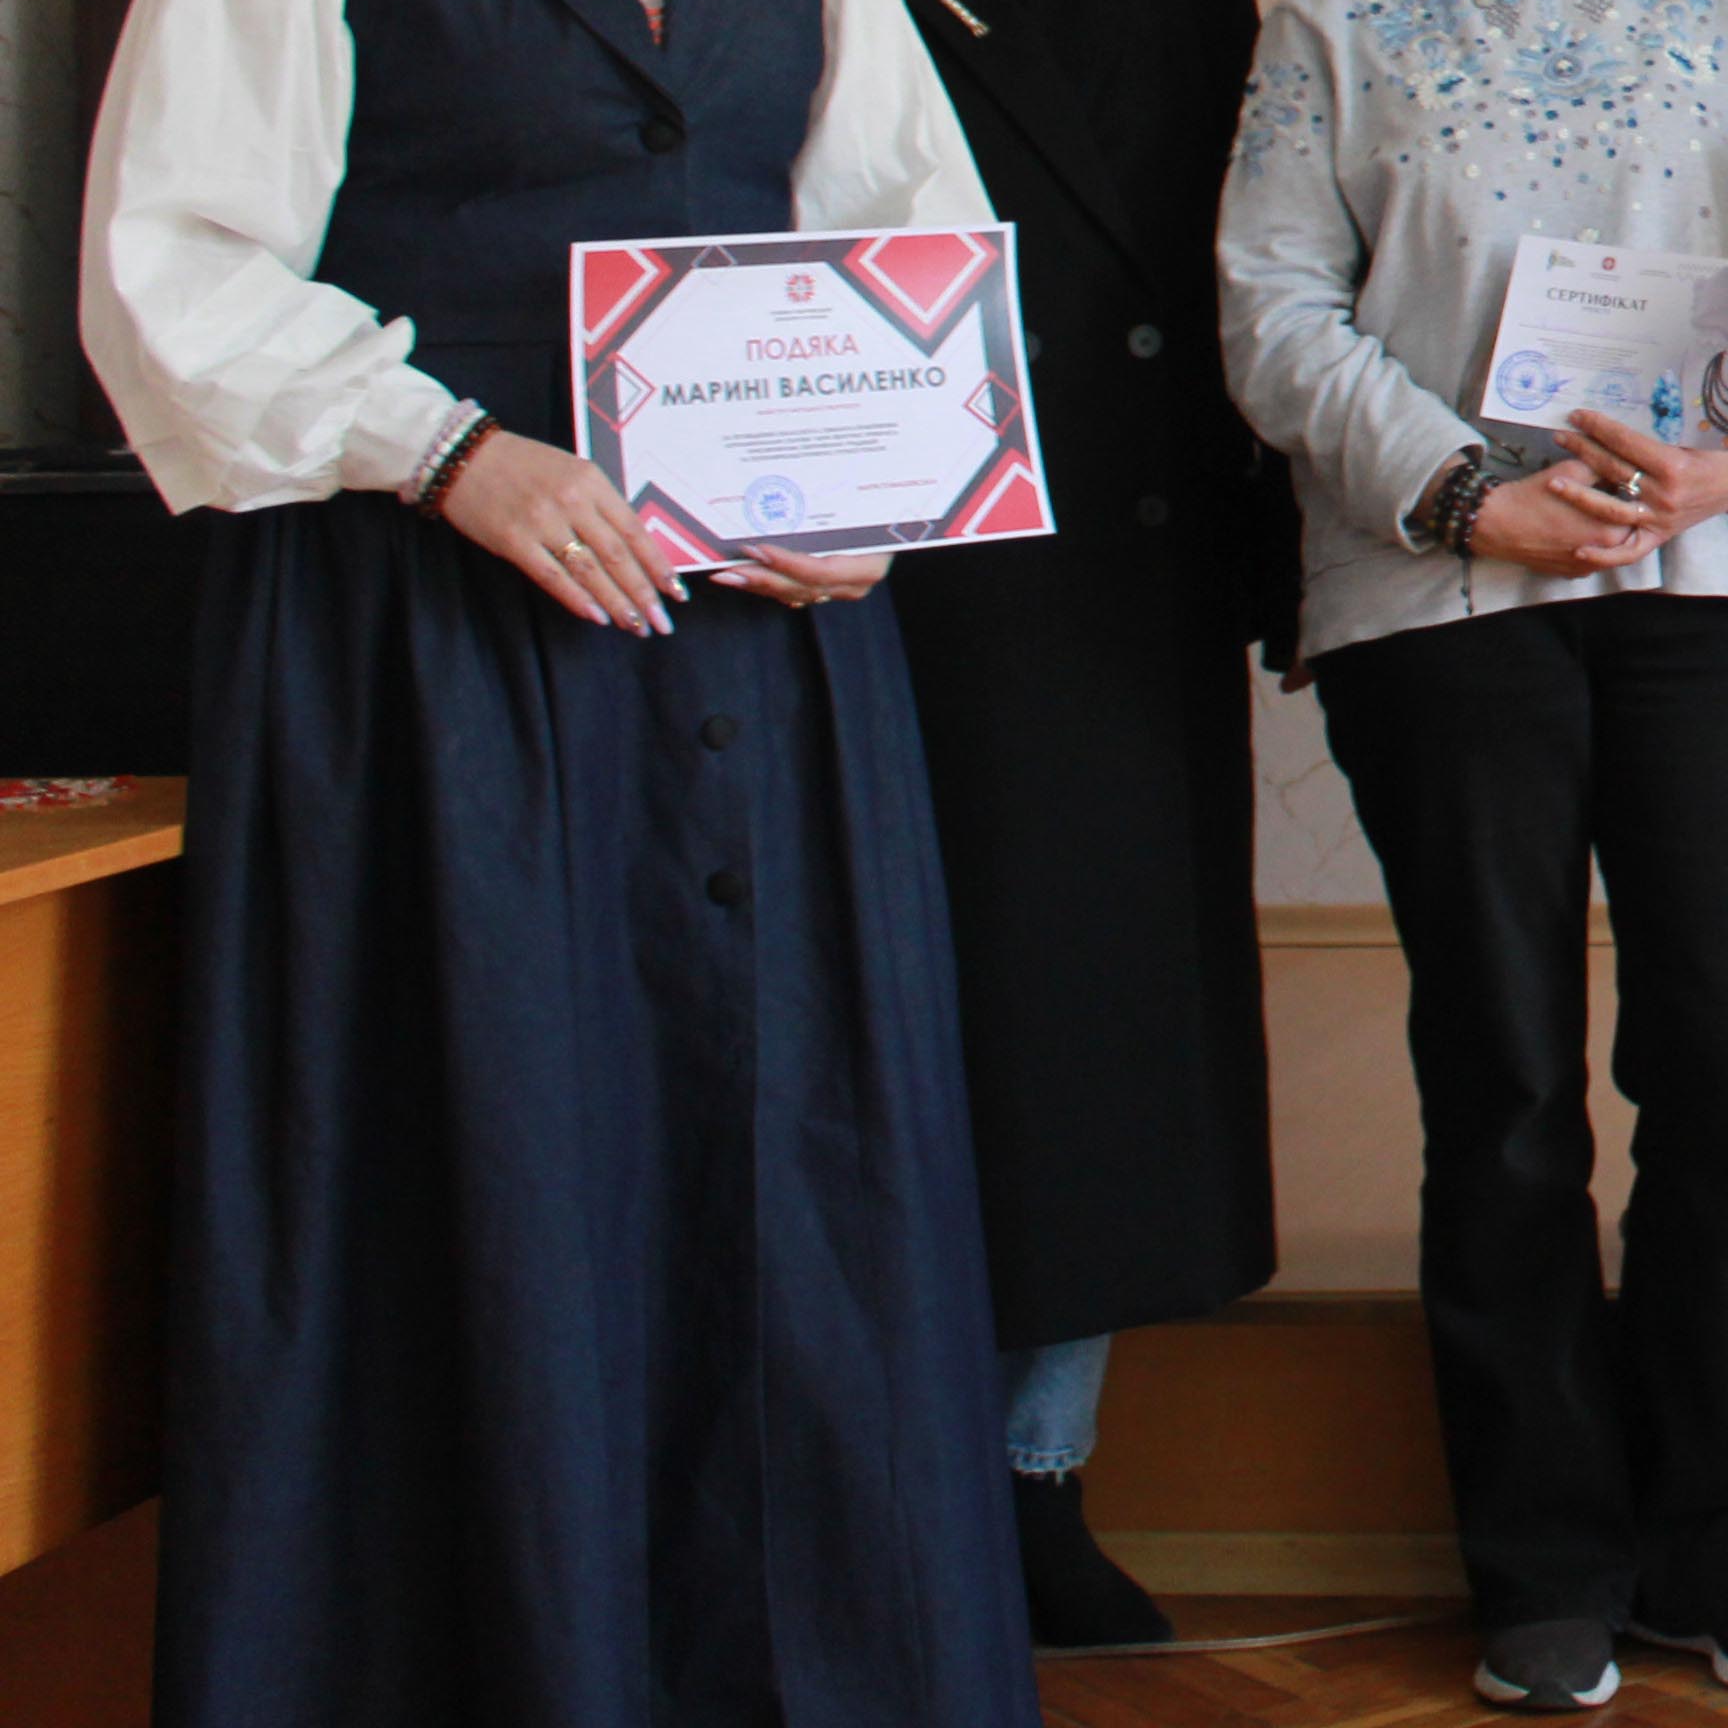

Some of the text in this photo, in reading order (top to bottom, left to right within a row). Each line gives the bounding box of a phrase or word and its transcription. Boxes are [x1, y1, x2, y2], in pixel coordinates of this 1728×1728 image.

[1546, 287, 1648, 312] СЕРТИФІКАТ
[745, 333, 860, 362] ПОДЯКА
[661, 366, 946, 406] МАРИНІ ВАСИЛЕНКО
